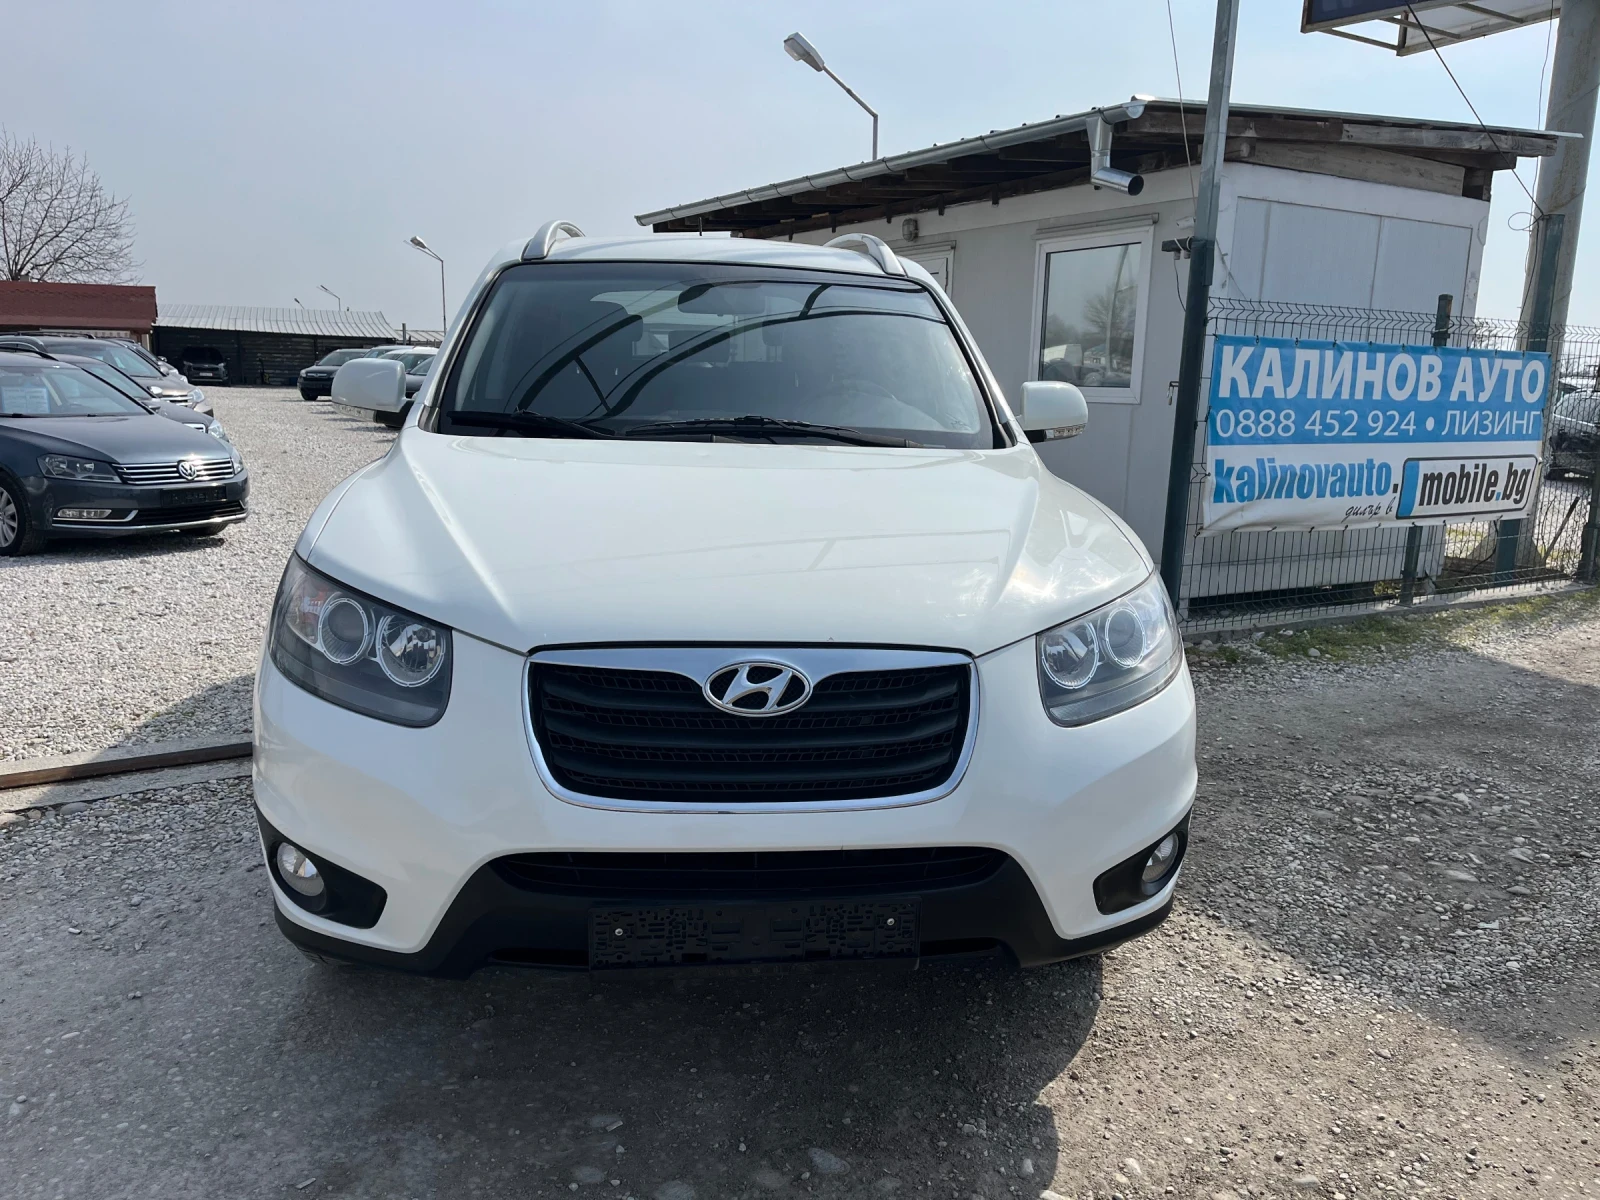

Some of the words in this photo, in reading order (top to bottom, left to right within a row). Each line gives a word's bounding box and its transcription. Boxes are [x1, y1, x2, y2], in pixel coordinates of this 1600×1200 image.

[1218, 345, 1442, 401] КАЛИНОВ
[1449, 356, 1545, 403] АУТО
[1216, 408, 1296, 437] 0888
[1304, 409, 1359, 437] 452
[1367, 410, 1417, 437] 924
[1441, 409, 1542, 436] ЛИЗИНГ
[1418, 462, 1532, 507] mobile.bg
